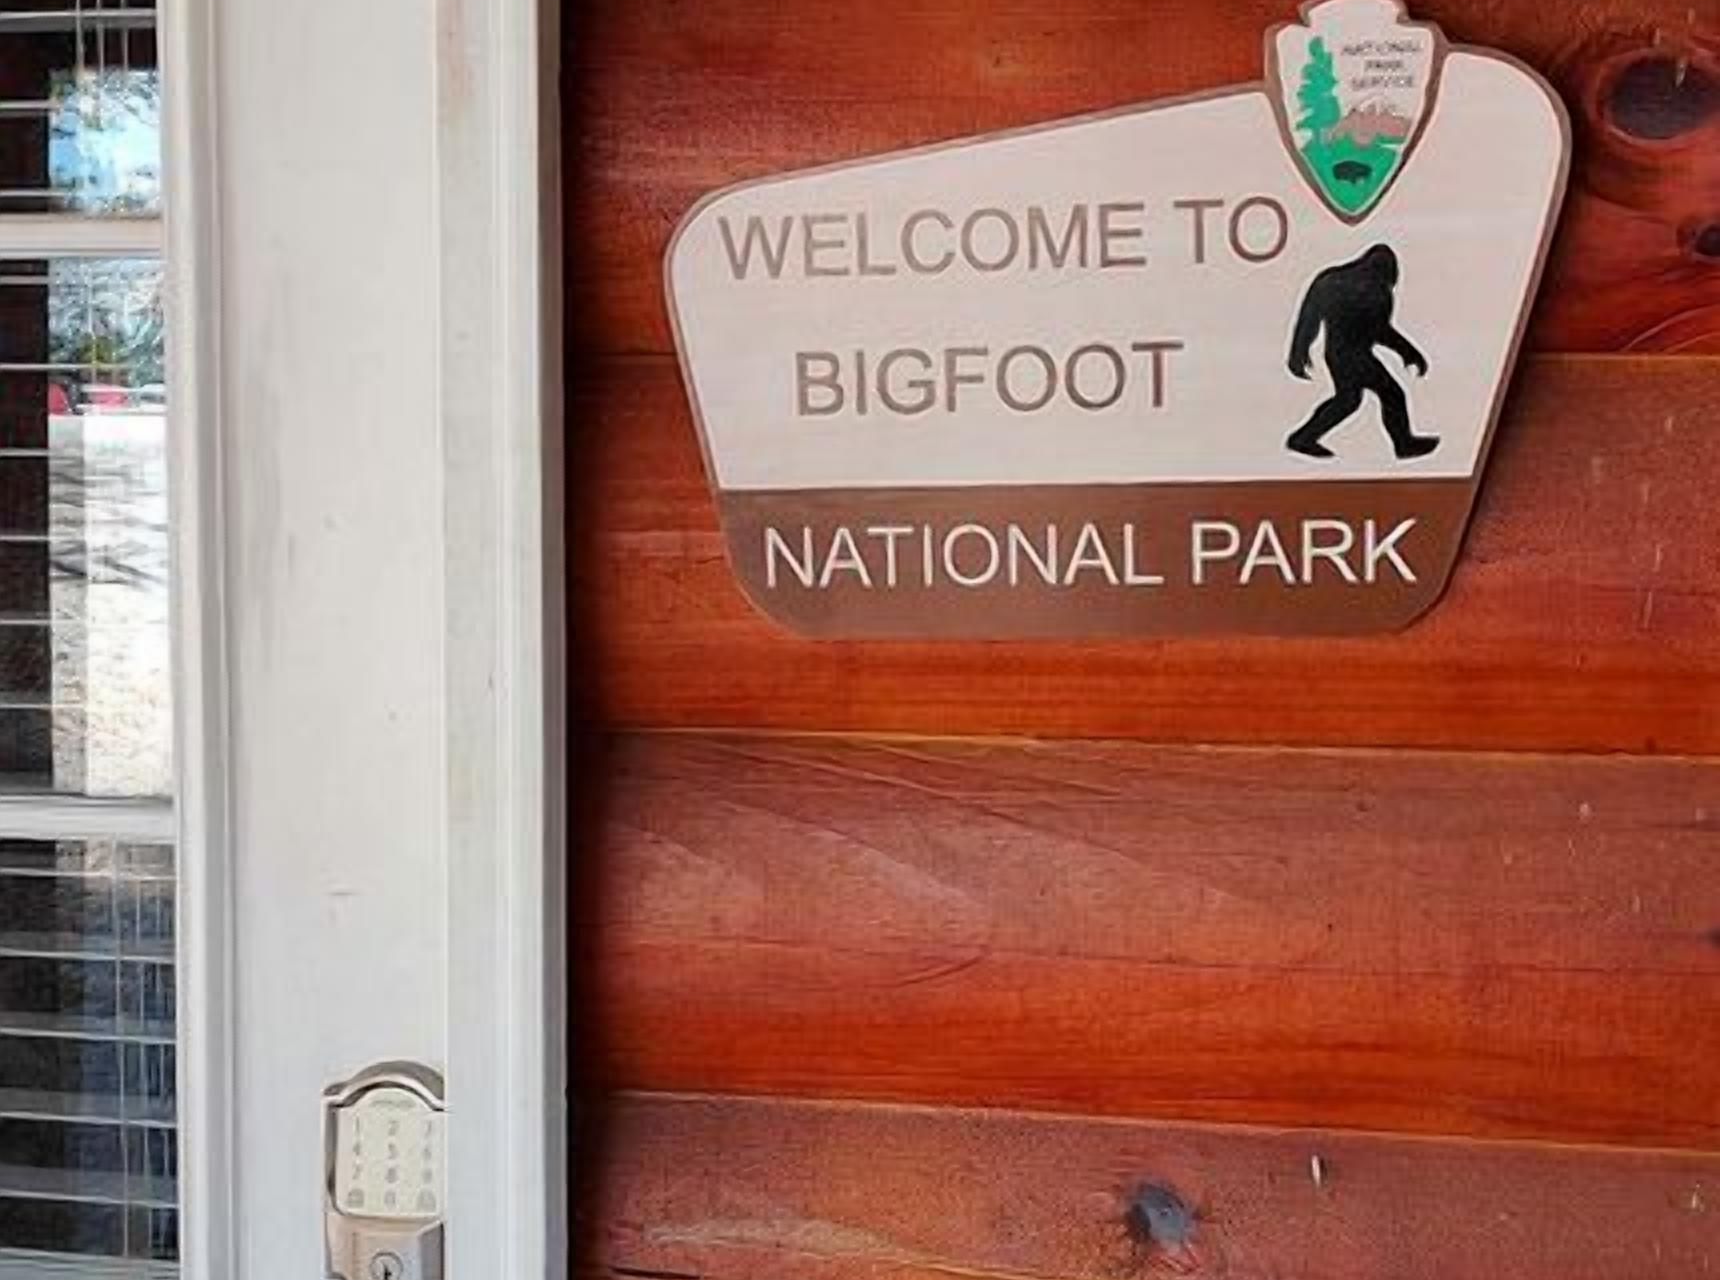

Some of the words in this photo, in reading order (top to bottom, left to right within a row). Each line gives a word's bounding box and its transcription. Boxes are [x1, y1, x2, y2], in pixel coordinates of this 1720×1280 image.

[1342, 40, 1422, 56] NATIONAL
[1351, 75, 1414, 91] SERVICE
[719, 202, 1147, 279] WELCOME
[1174, 196, 1289, 264] TO
[795, 340, 1184, 417] BIGFOOT
[763, 522, 1164, 588] NATIONAL
[1190, 516, 1418, 587] PARK
